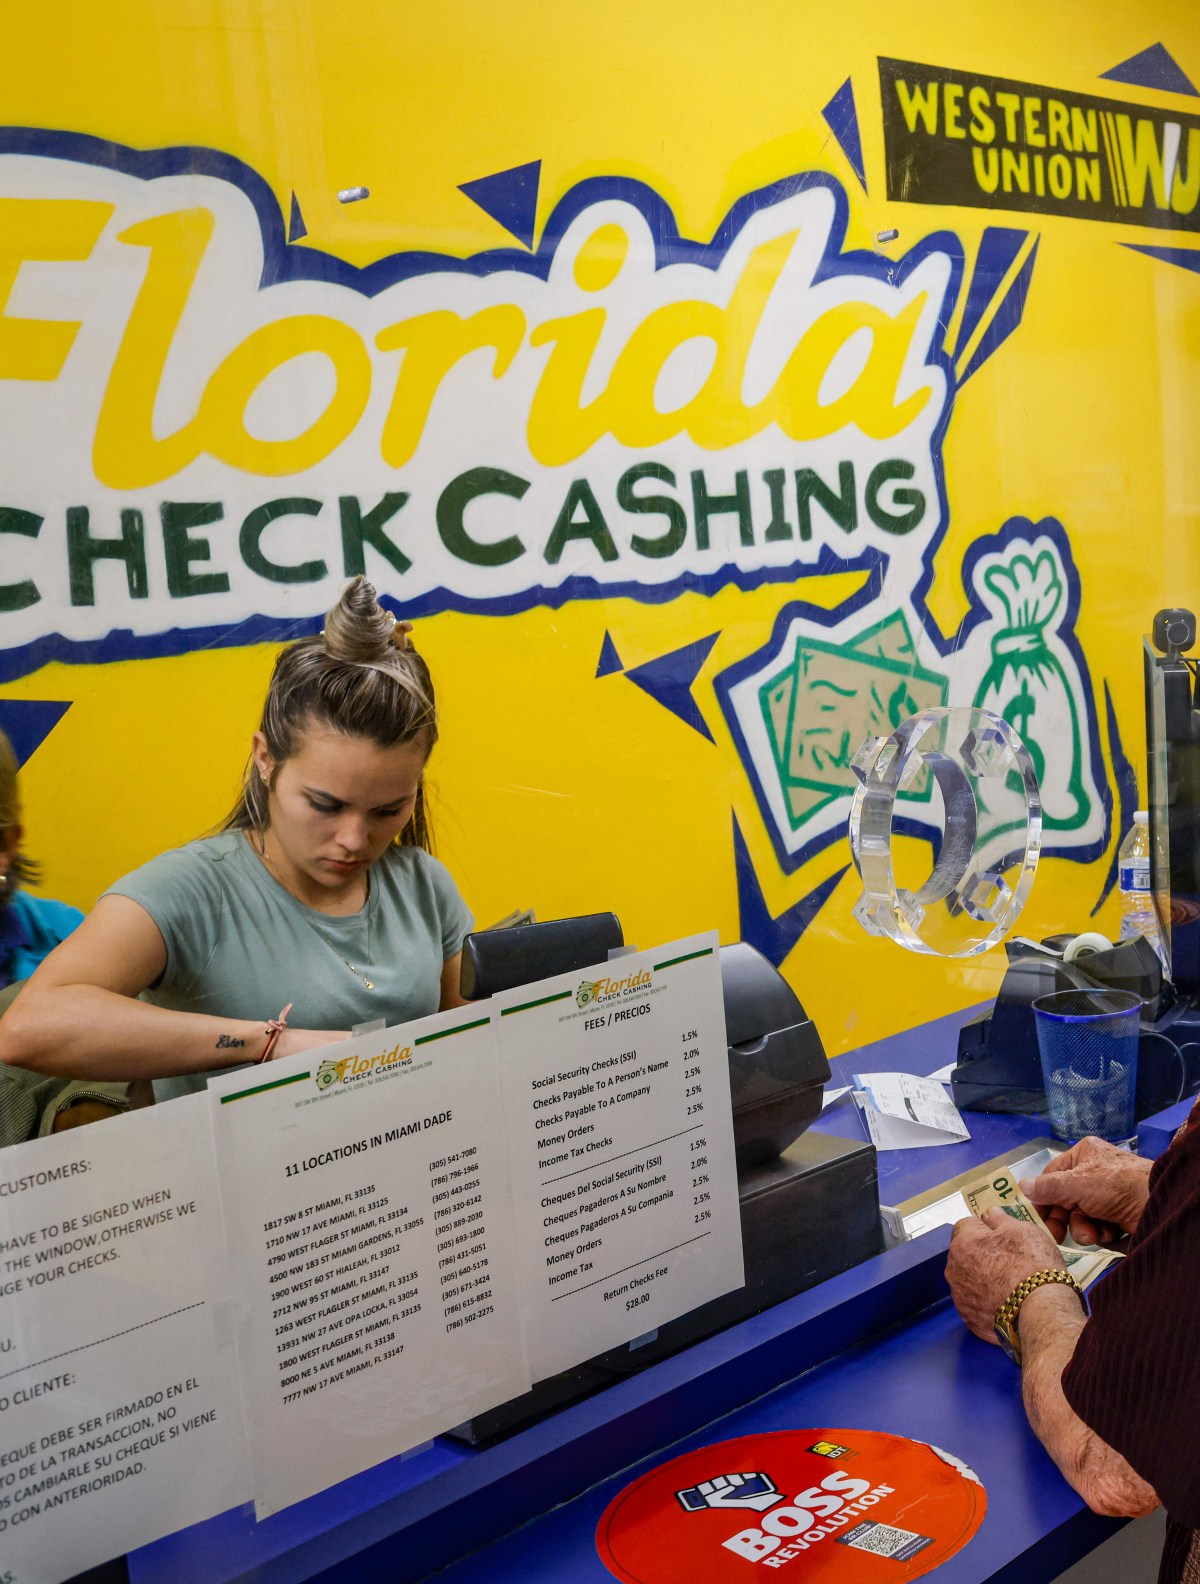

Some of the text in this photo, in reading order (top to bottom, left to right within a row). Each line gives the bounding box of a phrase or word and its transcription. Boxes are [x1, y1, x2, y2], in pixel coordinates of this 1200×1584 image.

[895, 78, 1099, 155] WESTERN
[973, 145, 1101, 202] UNION
[435, 460, 926, 567] CASHING
[591, 968, 652, 1002] Florida
[597, 982, 653, 1003] CHECK CASHING
[584, 1003, 651, 1031] FEES / PRECIOS
[681, 1029, 698, 1042] 1.5%
[335, 1043, 412, 1084] Florida
[342, 1058, 413, 1085] CHECK CASHING
[531, 1049, 637, 1090] Social Security Checks (SSI)
[683, 1047, 700, 1061] 2.0%
[532, 1094, 561, 1110] Checks
[562, 1083, 594, 1100] Payable
[595, 1080, 606, 1090] To
[607, 1077, 614, 1086] A
[647, 1060, 669, 1073] Name
[285, 1110, 452, 1177] 11 LOCATIONS IN MIAMI DADE
[429, 1146, 477, 1172] (305) 541-7080
[0, 1160, 92, 1197] CUSTOMERS:
[992, 1177, 1014, 1199] 10
[0, 1189, 171, 1253] HAVE TO BE SIGNED WHEN
[263, 1184, 376, 1231] 1817 SW 8 ST MIAMI, FL 33135
[4, 1200, 196, 1272] THE WINDOW,OTHERWISE WE
[26, 1248, 120, 1287] YOUR CHECKS.
[603, 1267, 668, 1301] Return Checks Fee
[625, 1292, 650, 1311] $28.00
[12, 1372, 76, 1405] CLIENTE:
[40, 1377, 199, 1450] DEBE SER FIRMADO EN EL
[14, 1409, 217, 1503] CAMBIARLE SU CHEQUE SI VIENE
[18, 1406, 176, 1480] DE LA TRANSACCION, NO
[826, 1445, 848, 1459] IDT
[10, 1462, 146, 1525] CON ANTERIORIDAD.
[720, 1470, 871, 1563] BOSS
[762, 1484, 896, 1569] REVOLUTION
